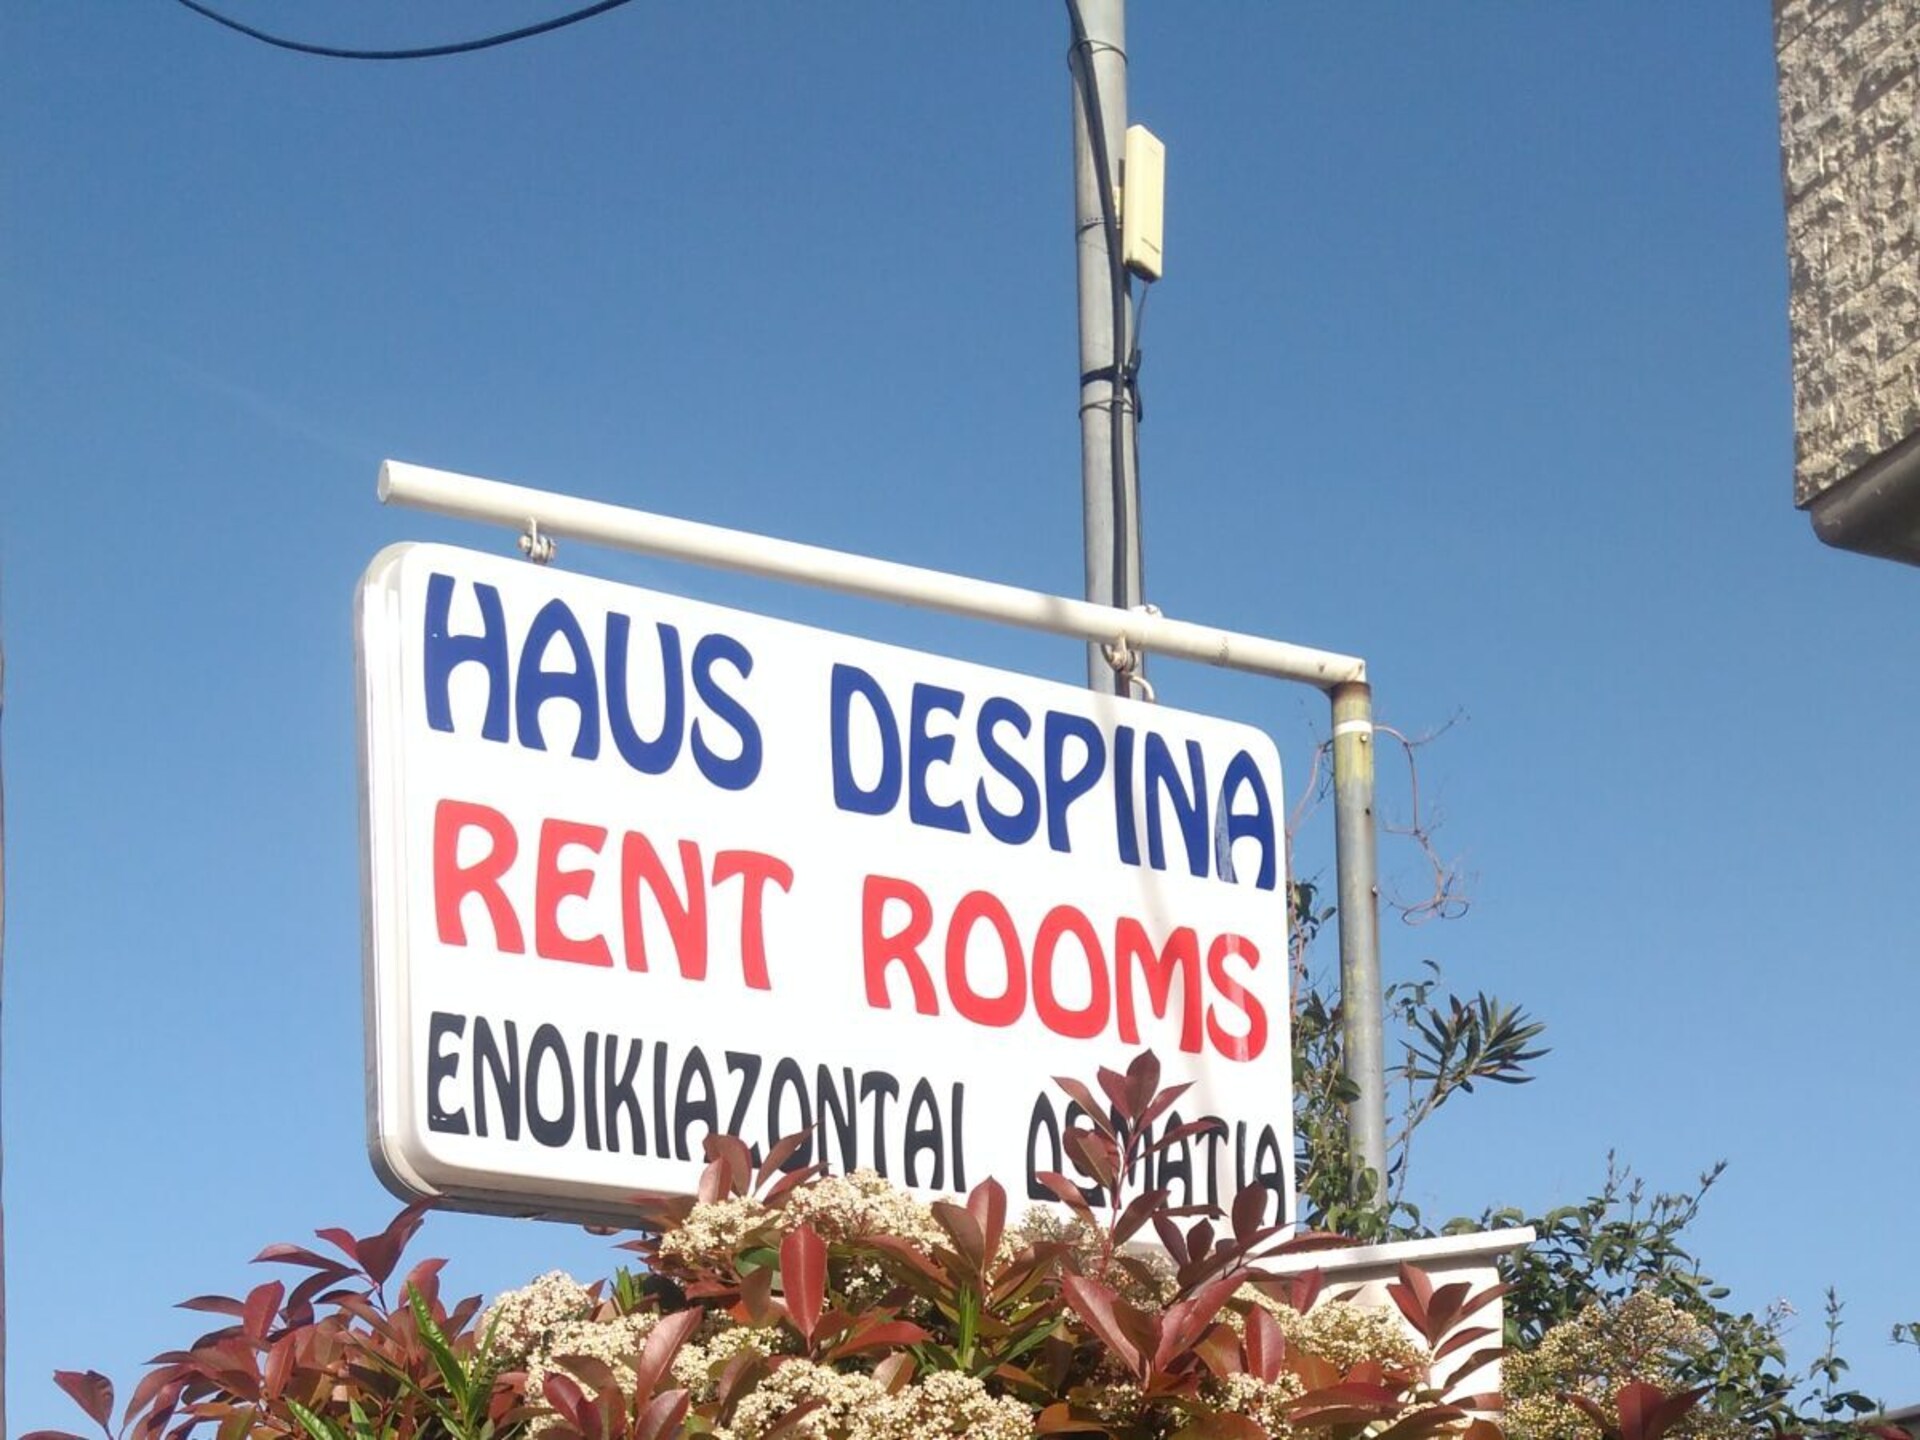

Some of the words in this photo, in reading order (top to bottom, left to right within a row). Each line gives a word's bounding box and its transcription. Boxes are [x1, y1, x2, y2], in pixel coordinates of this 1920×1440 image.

[424, 572, 763, 791] HAUS
[830, 663, 1276, 891] DESPINA
[433, 799, 795, 990] RENT
[862, 874, 1268, 1062] ROOMS
